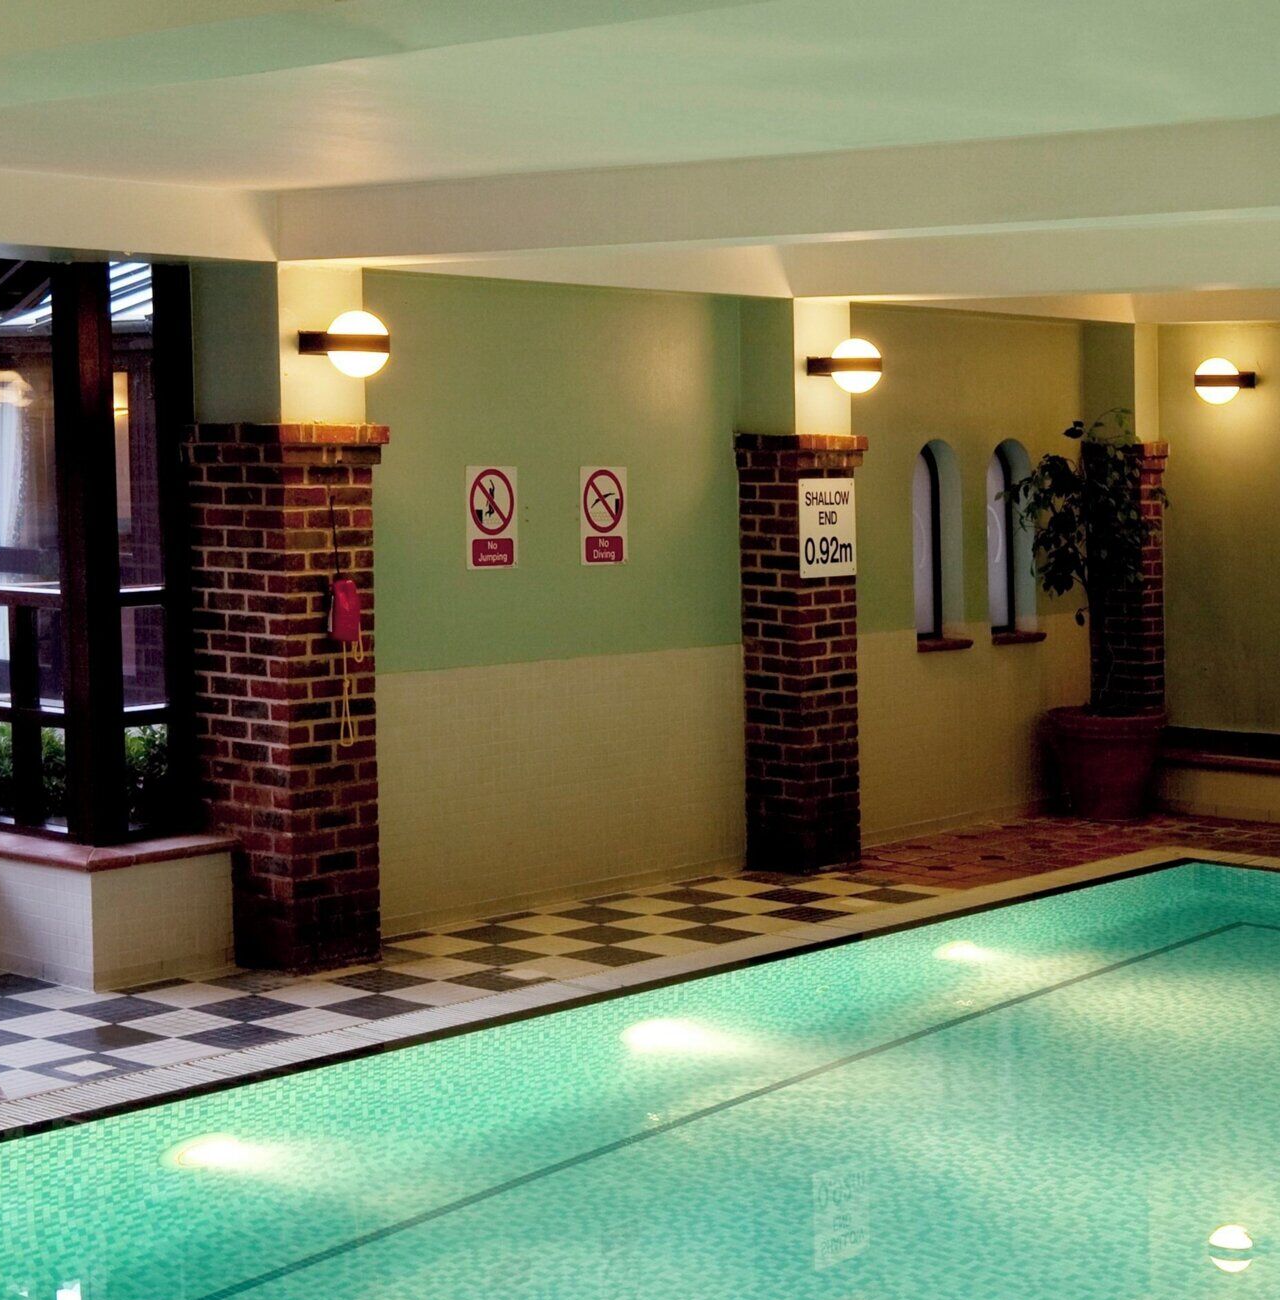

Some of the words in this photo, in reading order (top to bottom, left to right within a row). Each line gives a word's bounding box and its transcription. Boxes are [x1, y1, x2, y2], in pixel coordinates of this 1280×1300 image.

[805, 491, 849, 506] SHALLOW
[818, 511, 837, 525] END
[487, 540, 498, 550] No
[598, 538, 609, 548] No
[592, 549, 615, 560] Diving
[805, 537, 852, 565] 0.92m
[478, 553, 508, 563] Jumping
